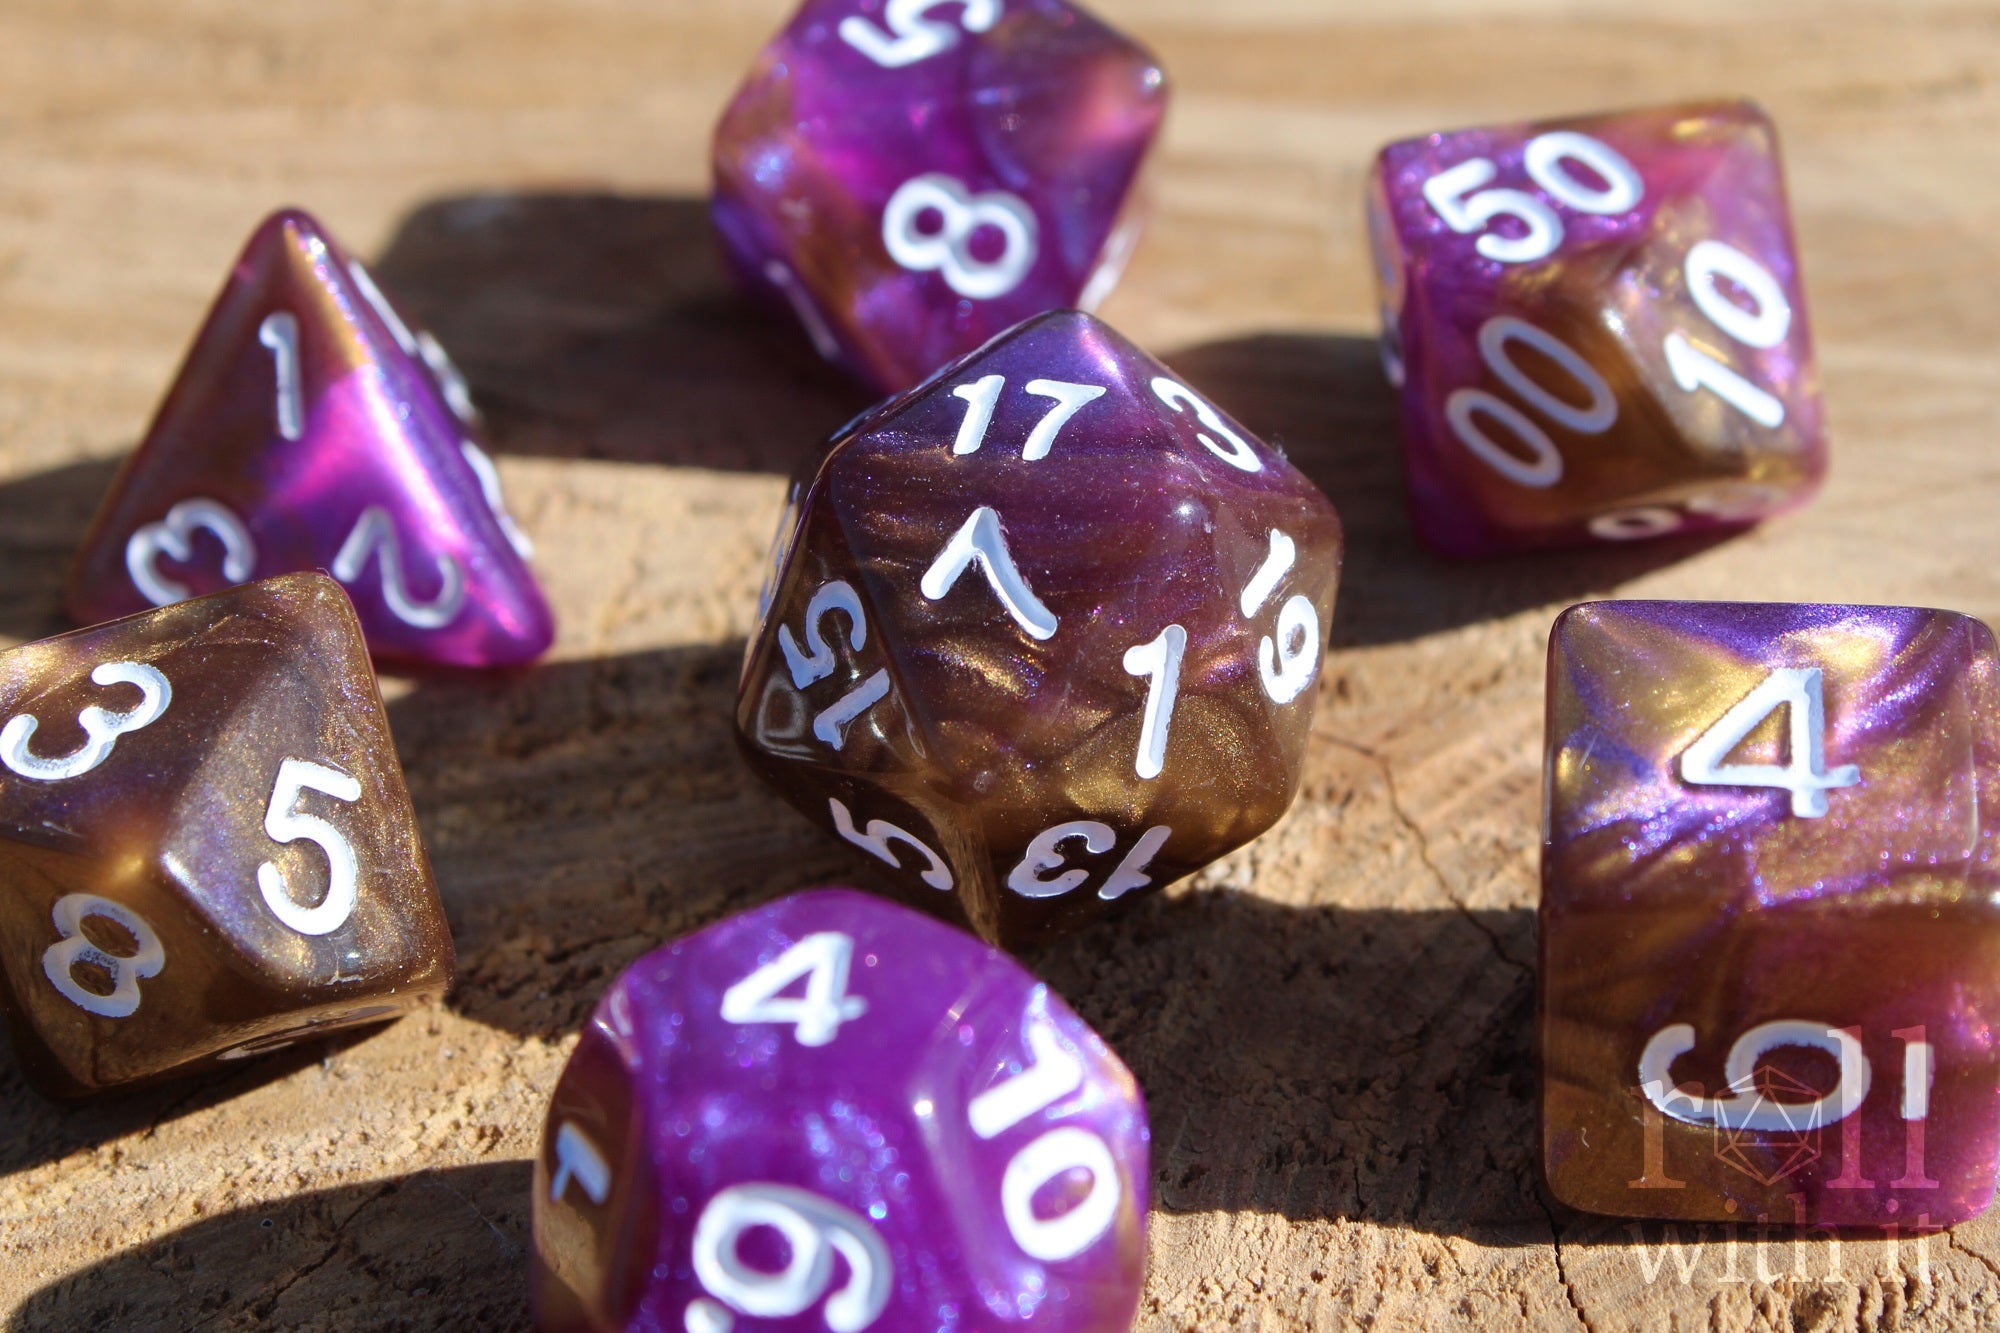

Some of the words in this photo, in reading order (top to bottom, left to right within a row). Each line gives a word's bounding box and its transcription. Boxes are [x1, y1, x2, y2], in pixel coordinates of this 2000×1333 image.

[882, 172, 1039, 300] 8
[1422, 131, 1645, 263] 50
[258, 311, 306, 441] 1
[1663, 239, 1792, 429] 10
[952, 374, 1106, 461] 17
[1150, 377, 1263, 473] 3
[1446, 316, 1618, 488] 00
[125, 498, 257, 606] 3
[333, 506, 466, 629] 2
[920, 506, 1058, 640] 7
[1, 661, 172, 780] 3
[1122, 624, 1188, 780] 1
[1680, 668, 1860, 819] 4
[258, 756, 361, 935] 5
[42, 894, 165, 1018] 8
[720, 931, 868, 1047] 4
[968, 984, 1119, 1262] 10
